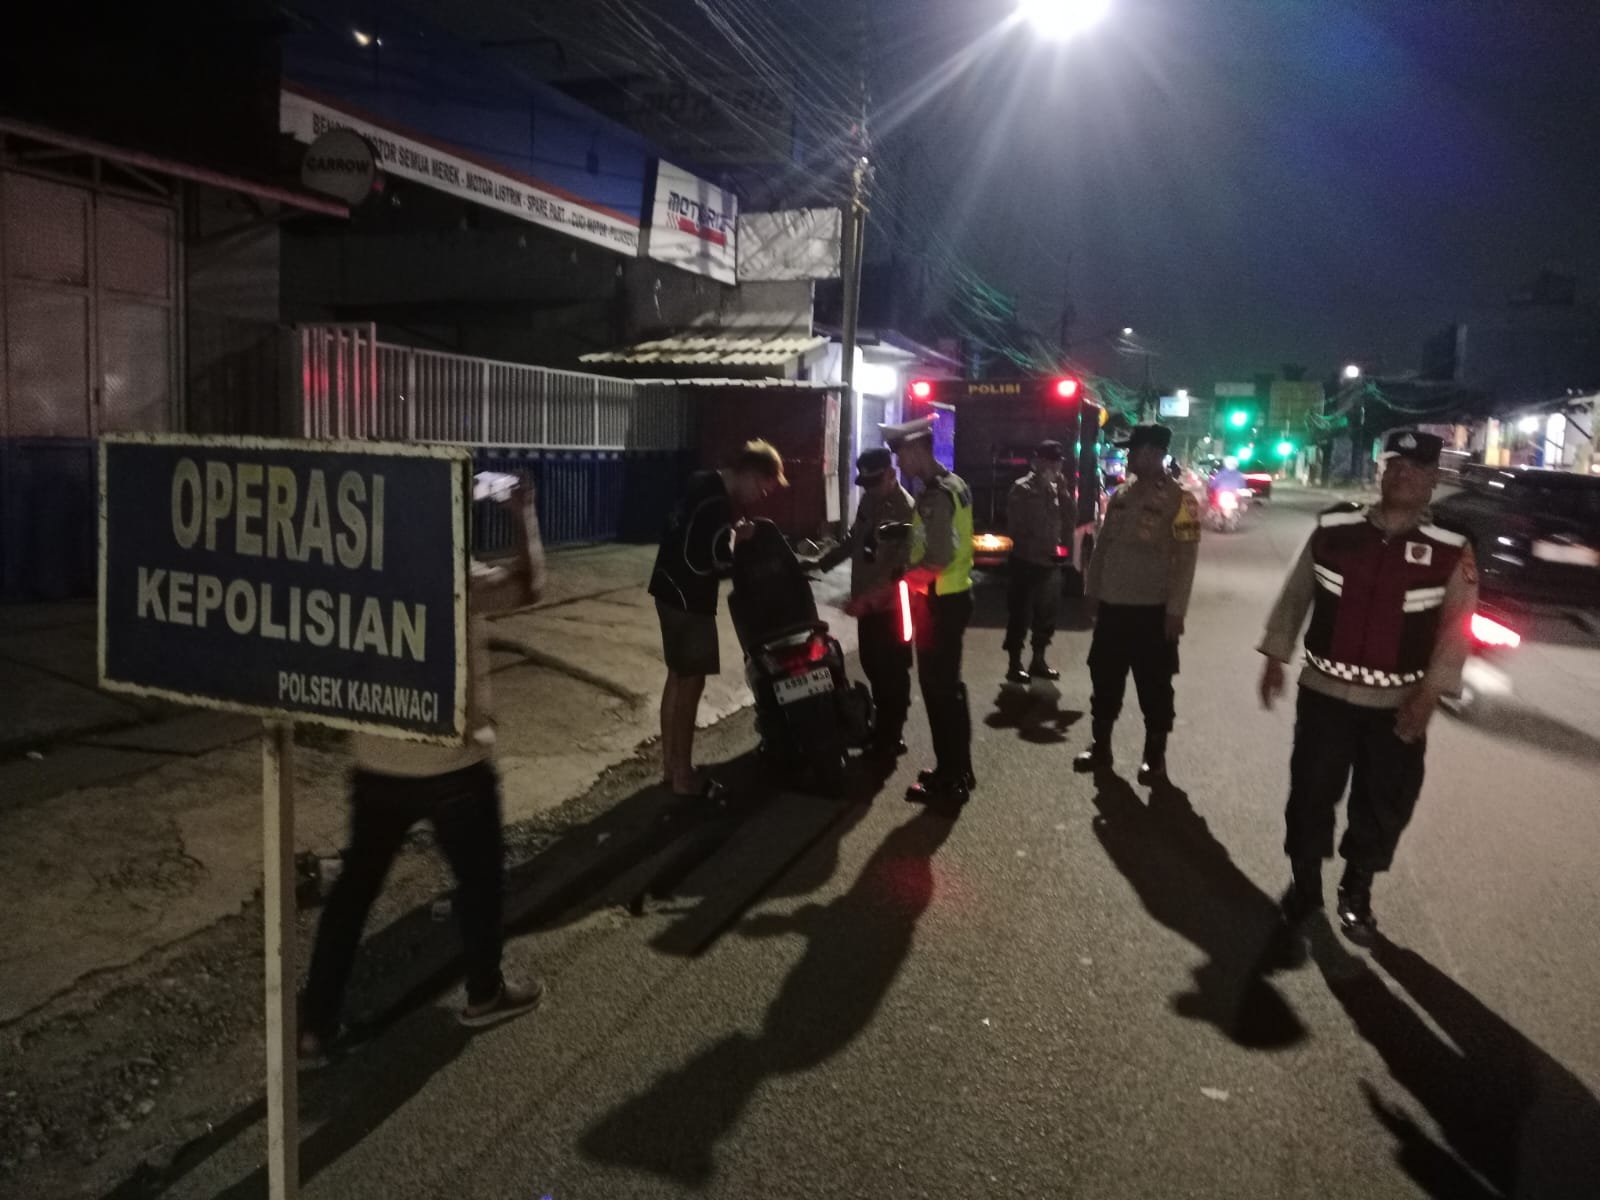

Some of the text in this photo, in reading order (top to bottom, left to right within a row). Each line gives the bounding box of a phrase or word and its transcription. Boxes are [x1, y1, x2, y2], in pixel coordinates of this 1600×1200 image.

[399, 146, 430, 175] SEMUA
[431, 158, 460, 187] MEREK
[466, 171, 493, 199] MOTOR
[494, 181, 523, 208] LISTRIK
[968, 384, 1021, 395] POLISI
[171, 457, 385, 571] OPERASI
[136, 565, 427, 663] KEPOLISIAN
[278, 670, 439, 723] POLSEK KARAWACI
